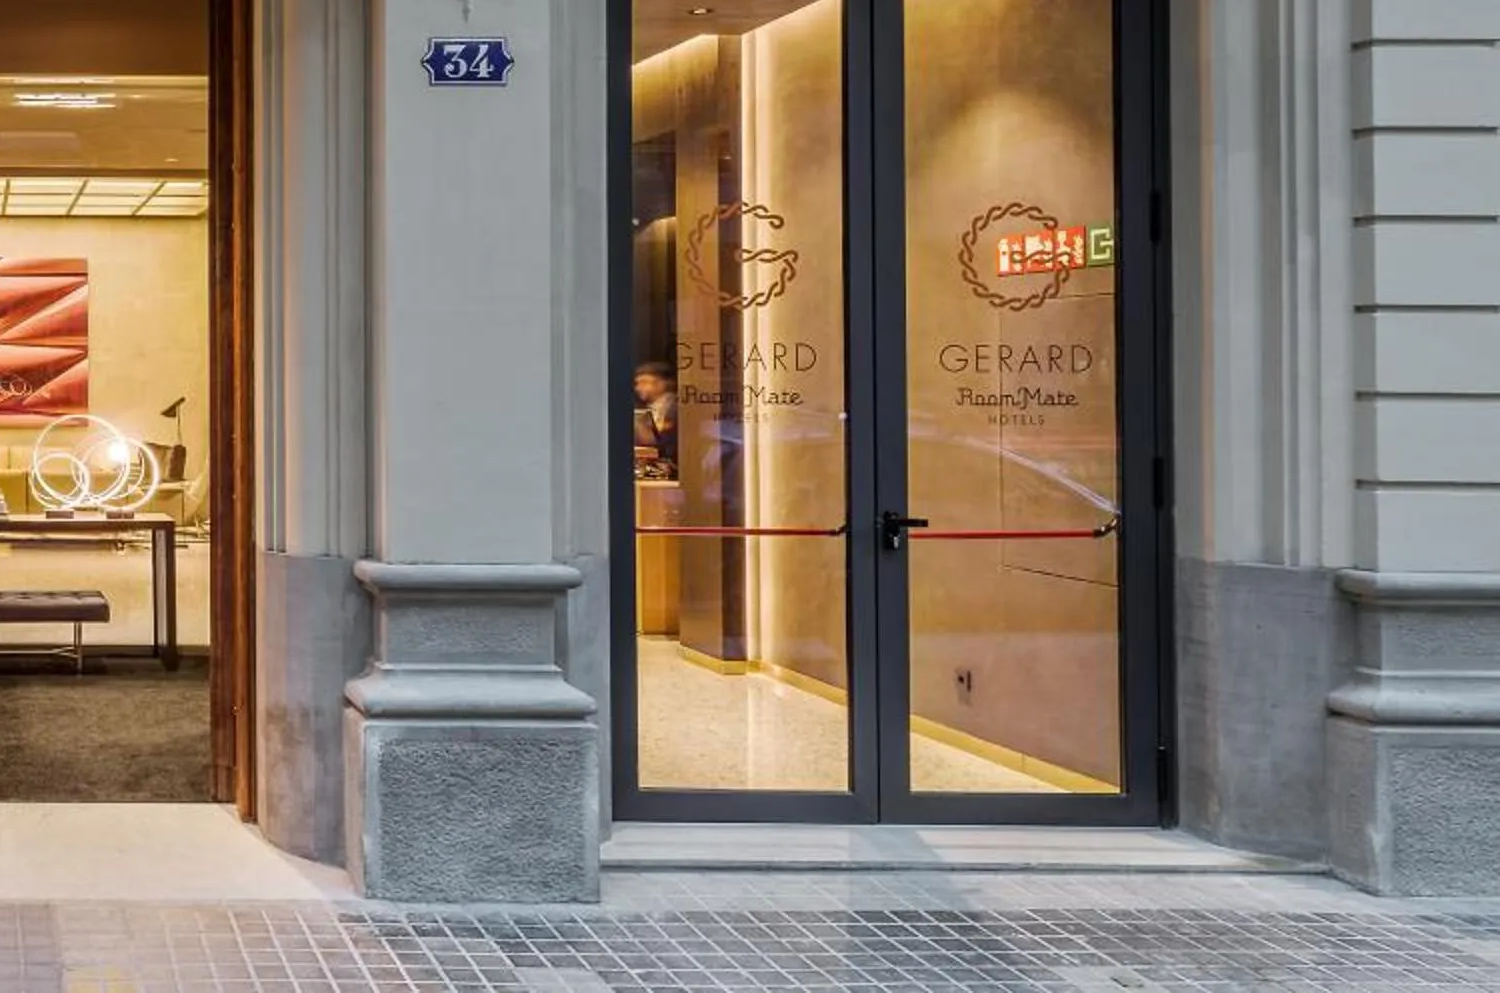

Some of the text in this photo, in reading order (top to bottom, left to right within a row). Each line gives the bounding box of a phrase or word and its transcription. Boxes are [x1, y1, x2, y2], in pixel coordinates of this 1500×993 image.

[443, 44, 494, 78] 34
[674, 342, 817, 371] GERARD
[939, 344, 1093, 373] GERARD
[988, 414, 1045, 426] HOTELS
